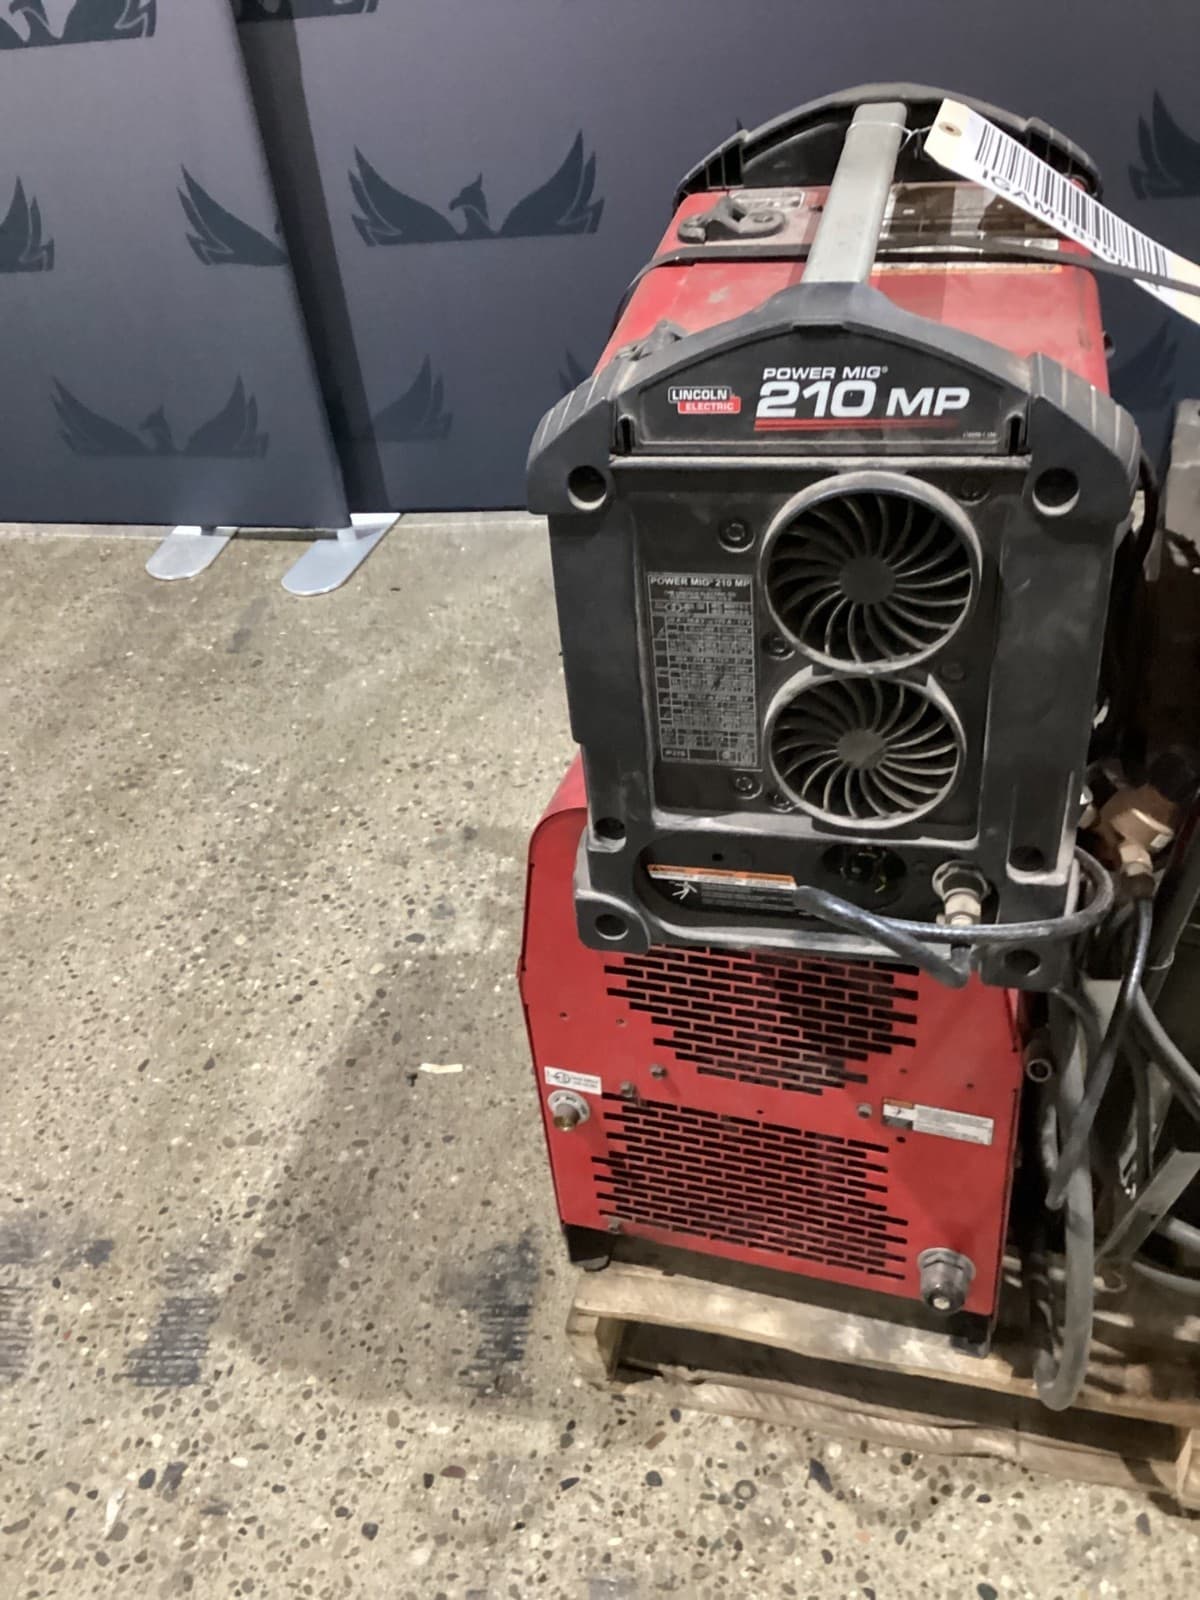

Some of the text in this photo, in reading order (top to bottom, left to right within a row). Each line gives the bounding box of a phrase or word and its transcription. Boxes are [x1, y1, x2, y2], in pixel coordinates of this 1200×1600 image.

[762, 366, 836, 380] POWER
[671, 388, 728, 401] LINCOLN
[755, 380, 970, 418] 210 MP
[685, 402, 734, 412] ELECTRIC
[650, 576, 688, 586] POWER
